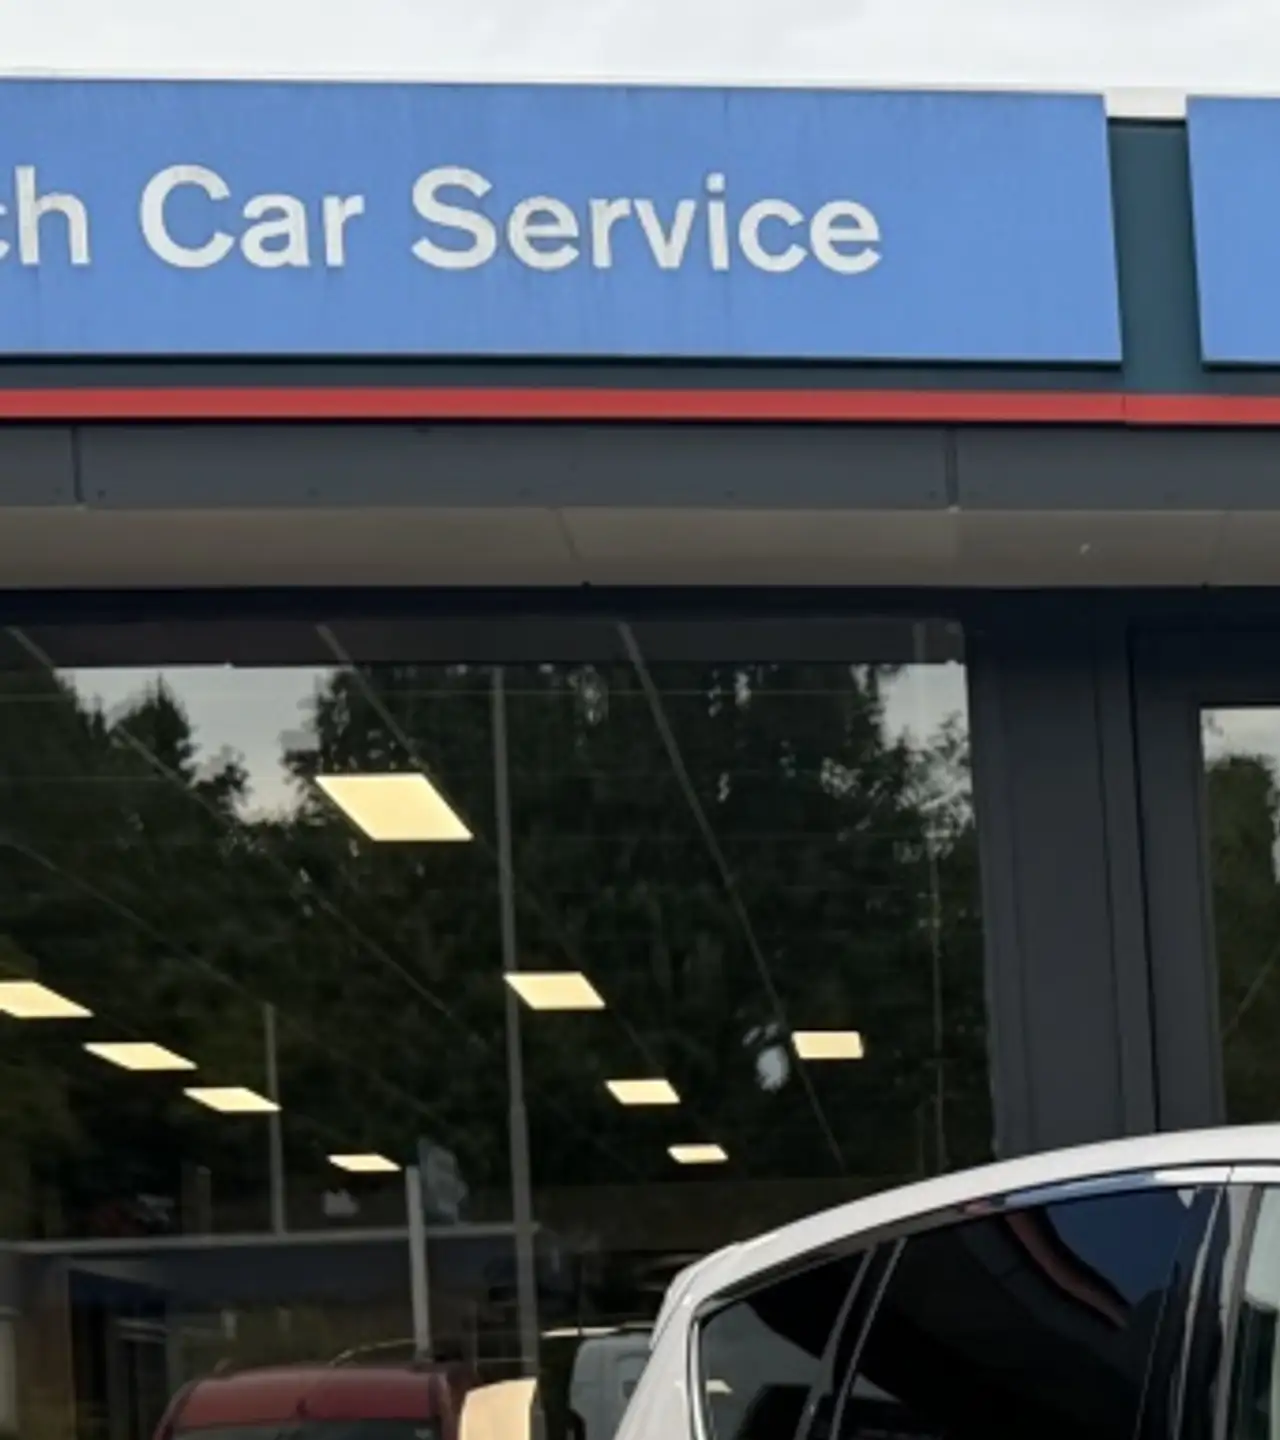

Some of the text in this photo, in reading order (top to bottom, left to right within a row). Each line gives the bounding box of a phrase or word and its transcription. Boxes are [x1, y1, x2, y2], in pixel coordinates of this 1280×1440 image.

[0, 163, 881, 274] h Car Service
